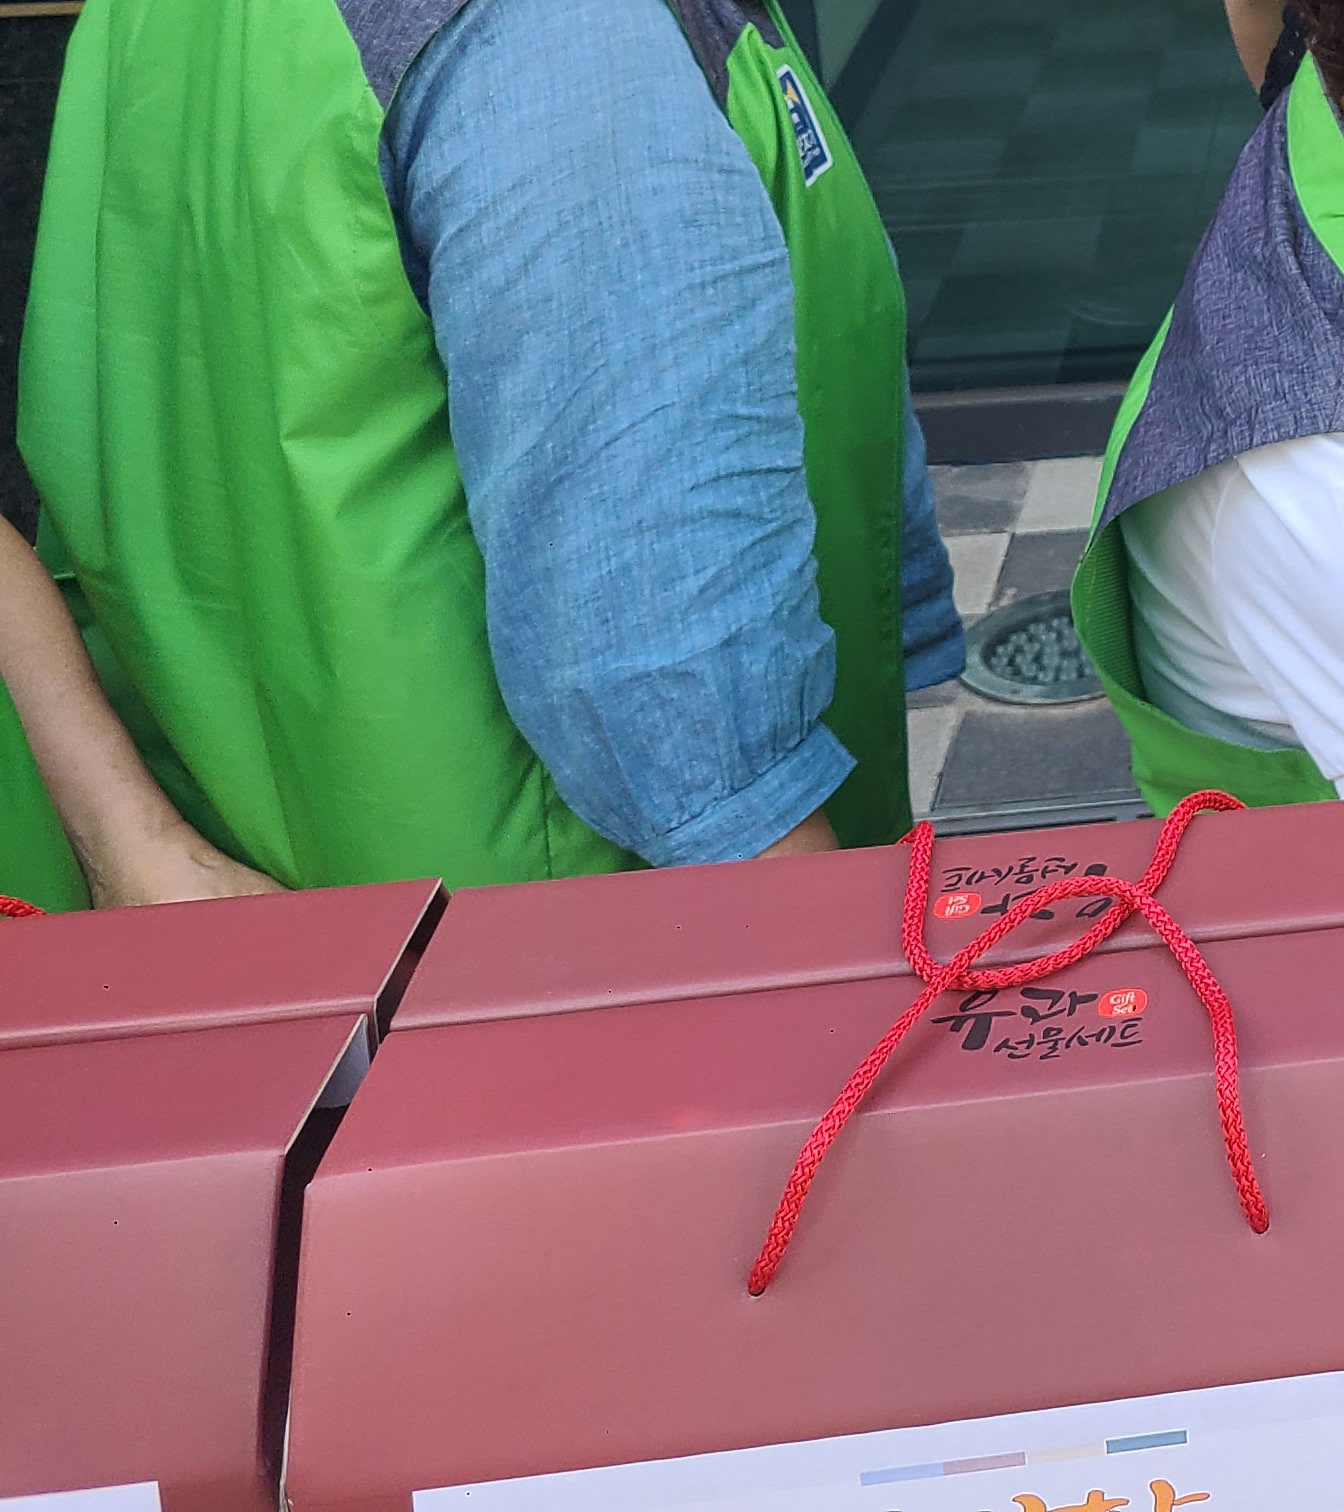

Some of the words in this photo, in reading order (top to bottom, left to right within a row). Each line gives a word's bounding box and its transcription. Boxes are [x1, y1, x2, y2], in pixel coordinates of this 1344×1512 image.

[1108, 992, 1137, 1005] Gift
[1112, 1003, 1137, 1015] Set
[994, 1017, 1143, 1060] 선물세트
